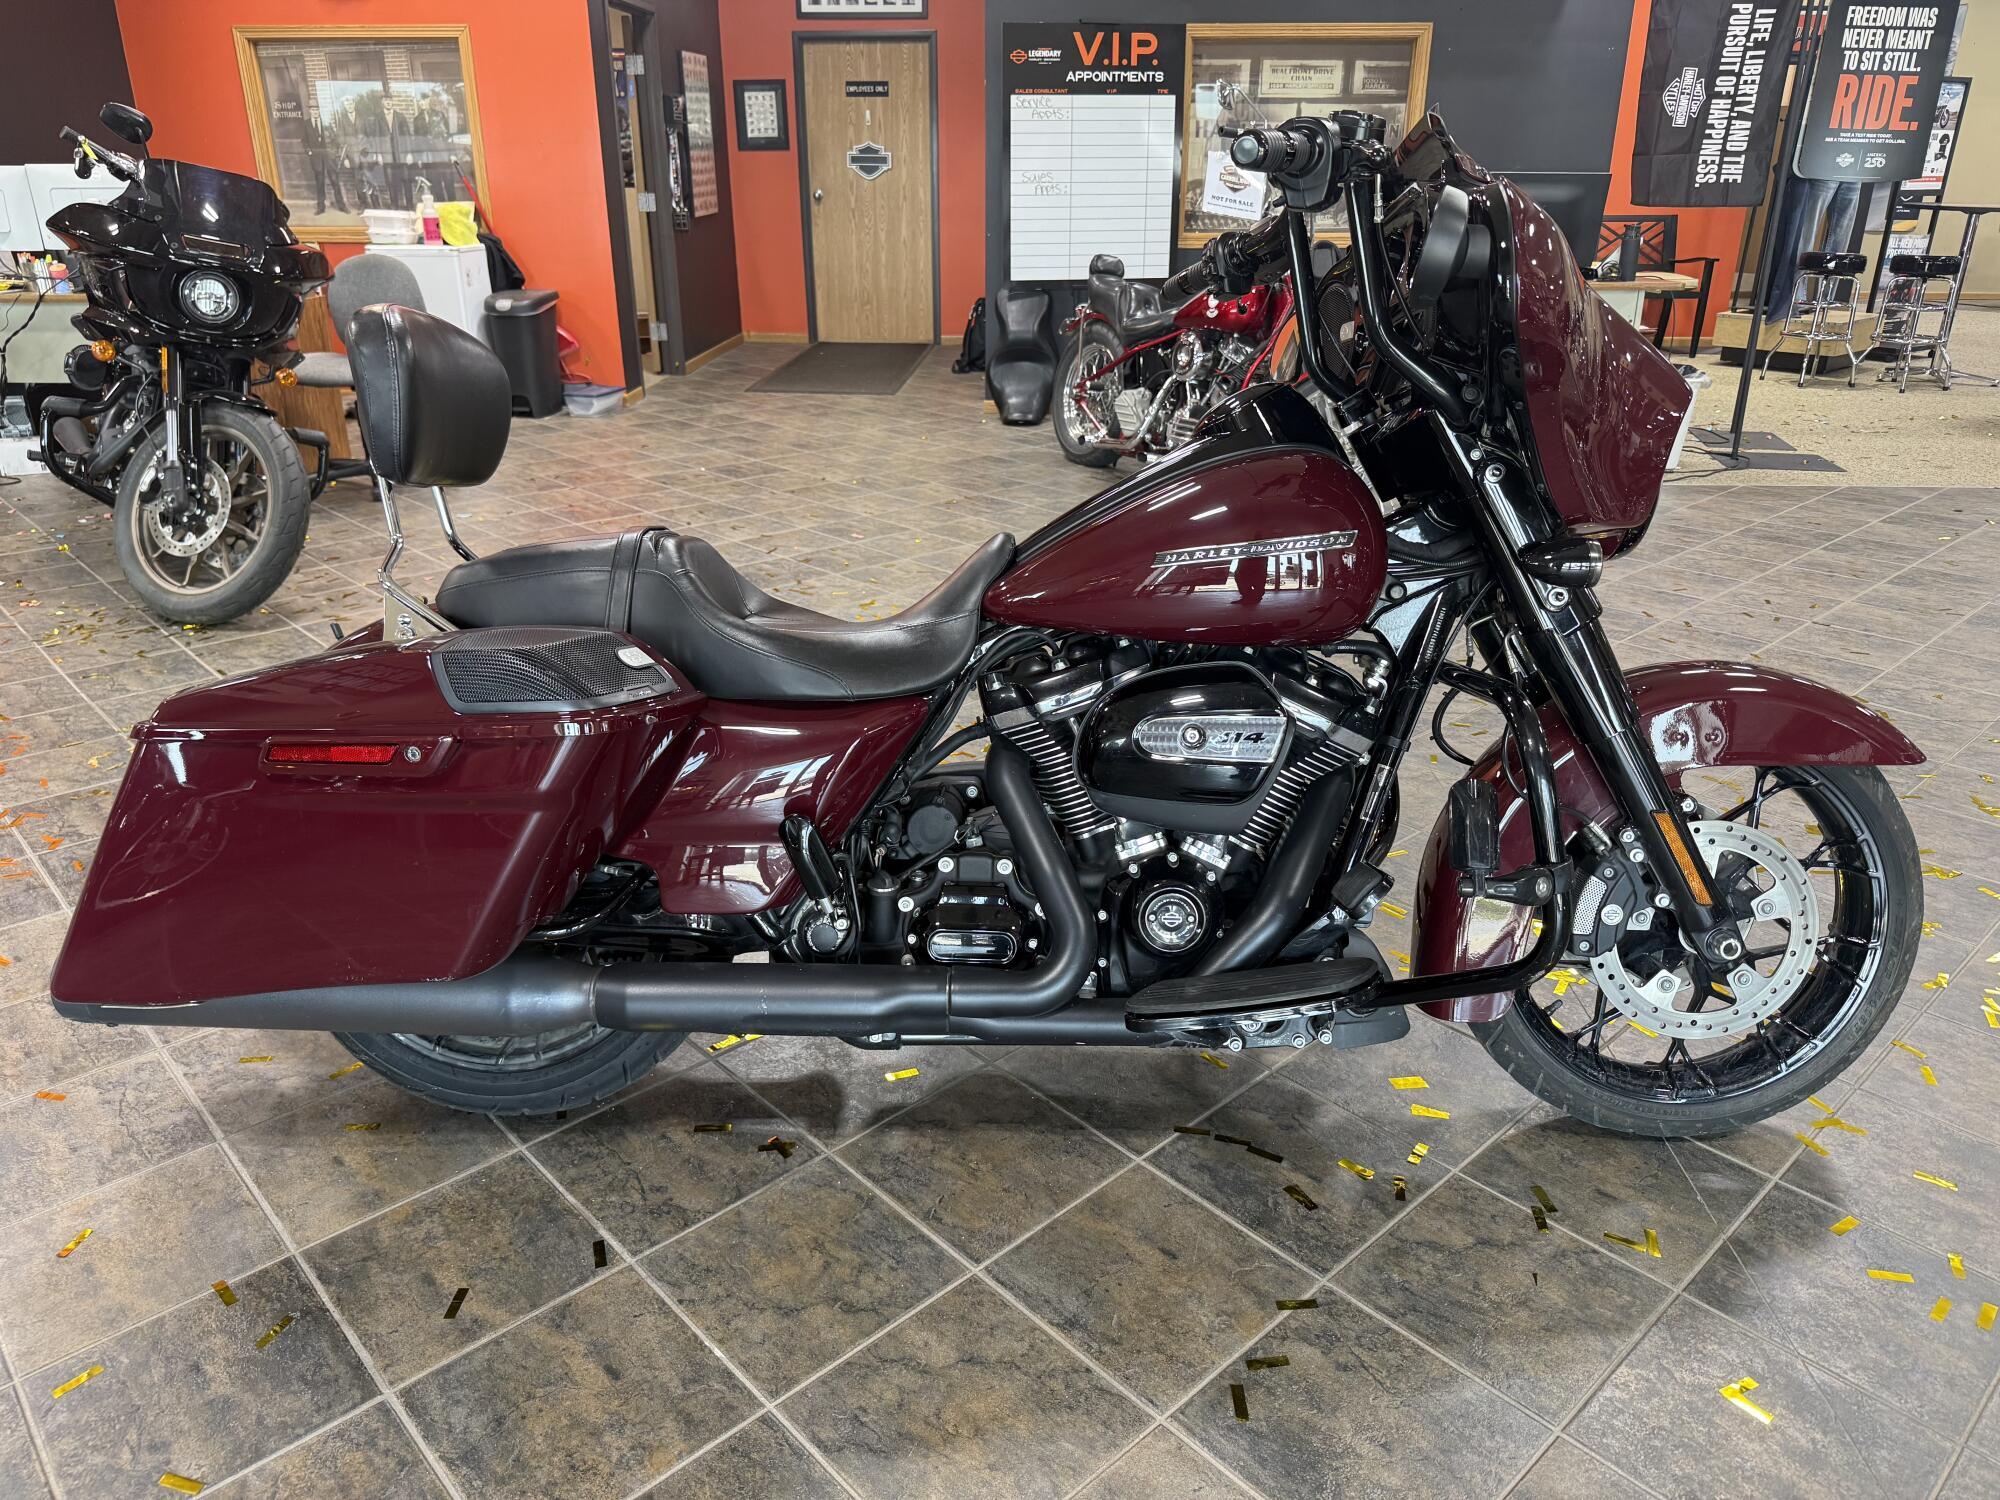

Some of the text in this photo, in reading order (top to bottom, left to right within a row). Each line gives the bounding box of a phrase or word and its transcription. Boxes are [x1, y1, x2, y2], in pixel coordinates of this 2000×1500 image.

[1845, 5, 1939, 28] FREEDOM WAS
[1072, 31, 1159, 67] V.I.P.
[1841, 28, 1934, 50] NEVER MEANT
[1028, 50, 1062, 58] LEGENDARY
[1842, 50, 1921, 72] TO SIT STILL.
[1065, 71, 1165, 83] APPOINTMENTS
[274, 101, 297, 110] SHOP
[1665, 82, 1680, 112] CYCLES
[1675, 70, 1695, 125] HARLEY-DAVIDSON
[1690, 83, 1703, 113] MOTOR
[1694, 3, 1753, 188] PURSUIT OF HAPPINESS.
[1720, 8, 1777, 184] LIFE, LIBERTY, AND THE
[1828, 73, 1920, 131] RIDE.
[273, 111, 303, 119] ENTRANCE
[1864, 157, 1886, 168] 250
[1211, 194, 1224, 202] NOT
[1238, 199, 1254, 207] SALE
[1164, 534, 1349, 564] HARLEY-DAVIDSON
